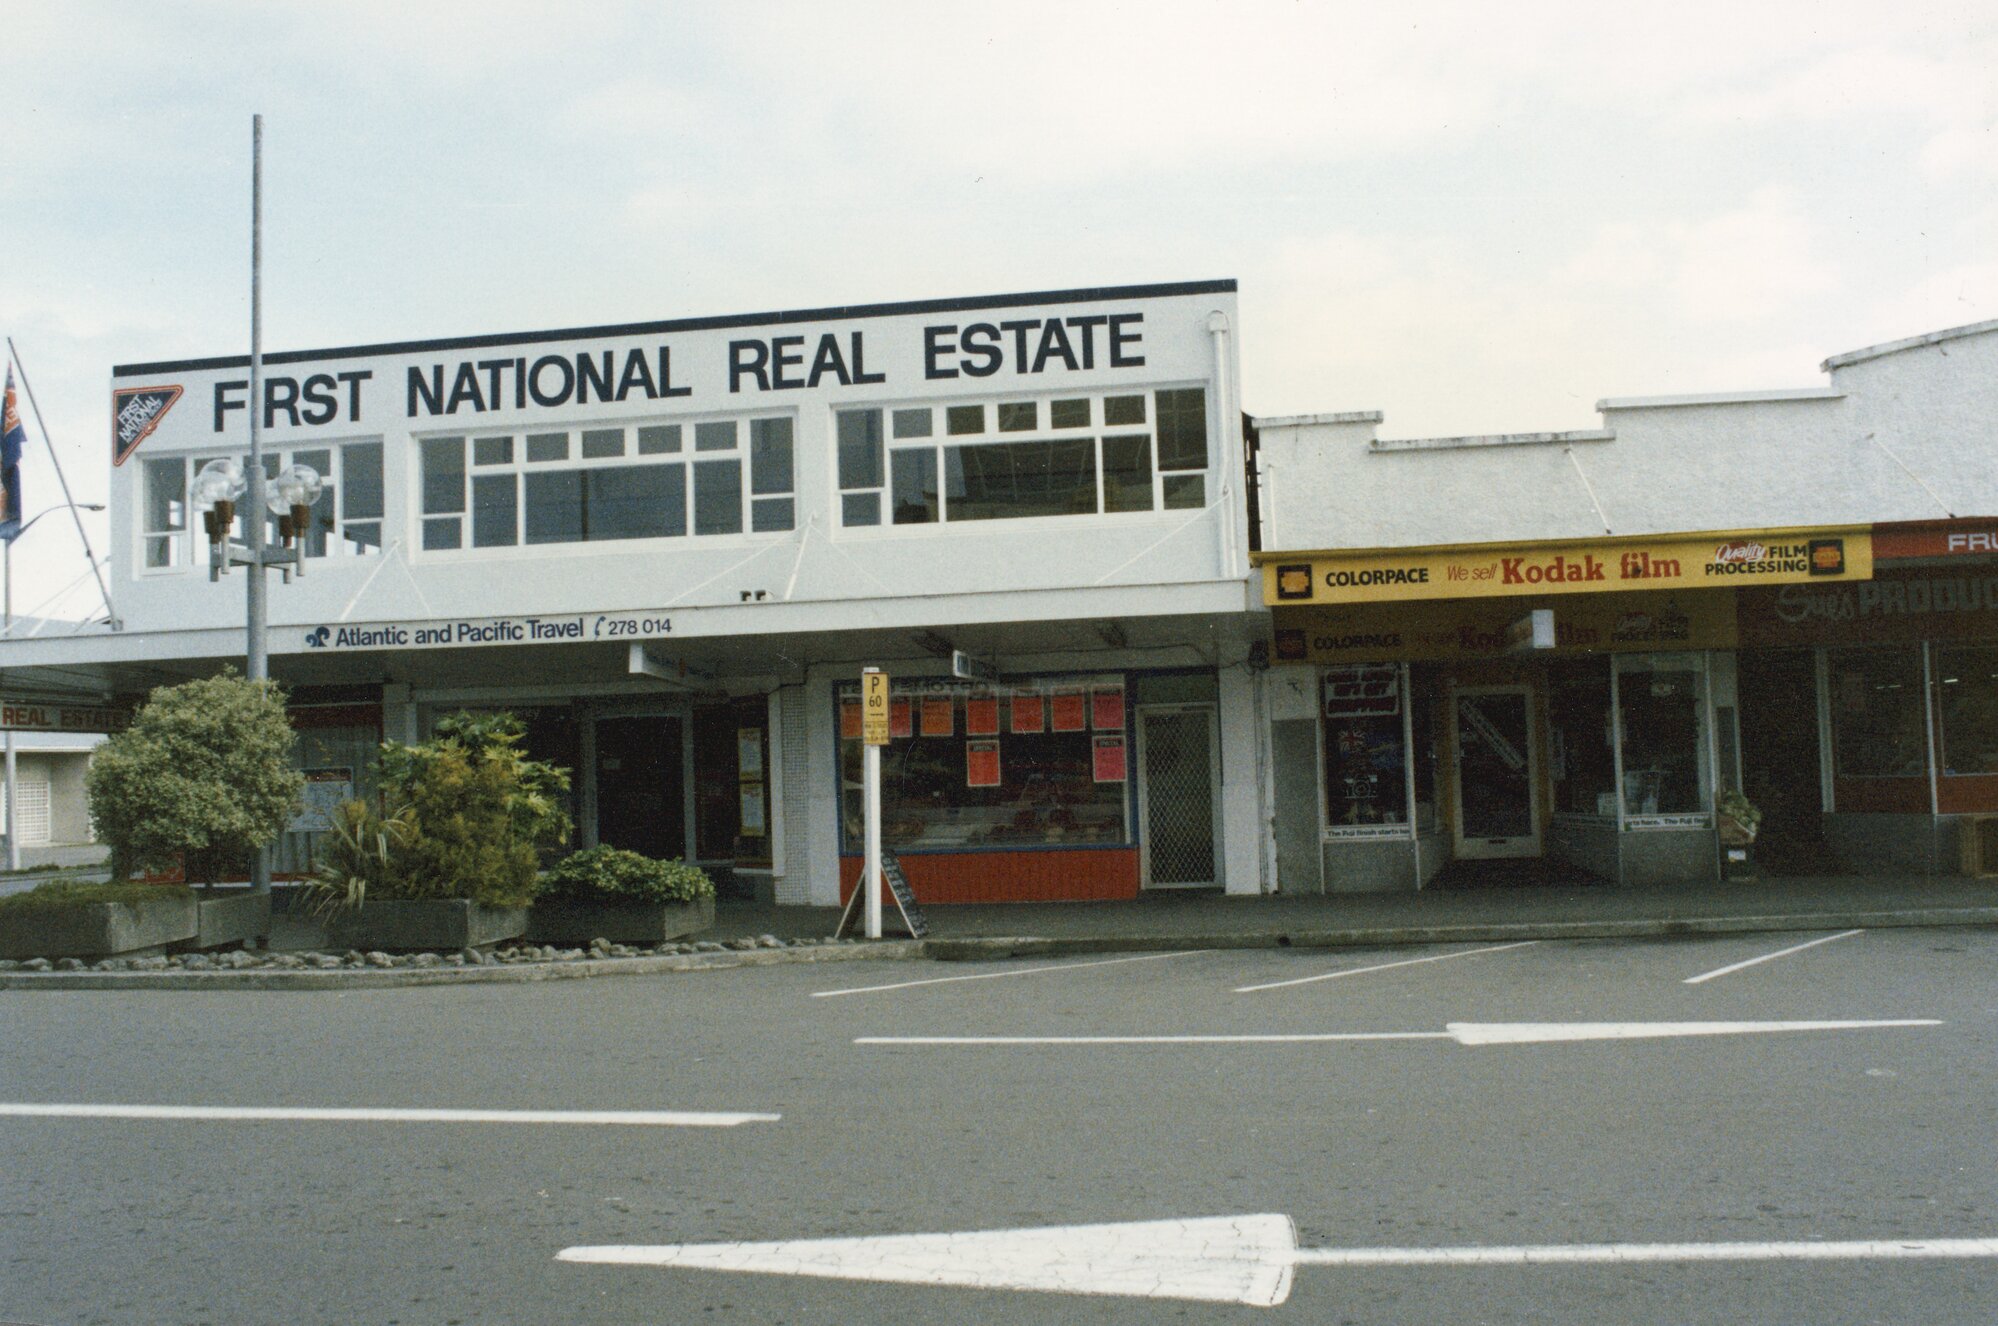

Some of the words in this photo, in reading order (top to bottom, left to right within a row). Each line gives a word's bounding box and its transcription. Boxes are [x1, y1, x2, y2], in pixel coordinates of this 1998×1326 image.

[213, 369, 373, 432] FRST
[406, 346, 692, 418] NATIONAL
[729, 331, 886, 393] REAL
[924, 312, 1146, 380] ESTATE
[117, 394, 145, 425] FIRST
[118, 395, 160, 443] NATIONAL
[1714, 541, 1767, 564] Quality
[1769, 544, 1808, 559] FILM
[1325, 567, 1429, 588] COLORPACE
[1447, 564, 1470, 582] We
[1472, 562, 1498, 580] sell
[1501, 554, 1606, 585] Kodak
[1619, 551, 1682, 580] film
[1704, 558, 1808, 576] PROCESSING
[335, 623, 408, 648] Atlantic
[414, 623, 453, 645] and
[457, 620, 523, 644] Pacific
[526, 618, 585, 641] Travel
[608, 618, 639, 636] 278
[642, 617, 673, 635] 014
[1313, 632, 1402, 650] COLORPACE
[871, 676, 880, 694] P
[868, 695, 883, 708] 60
[2, 706, 51, 728] REAL
[1328, 830, 1342, 838] The
